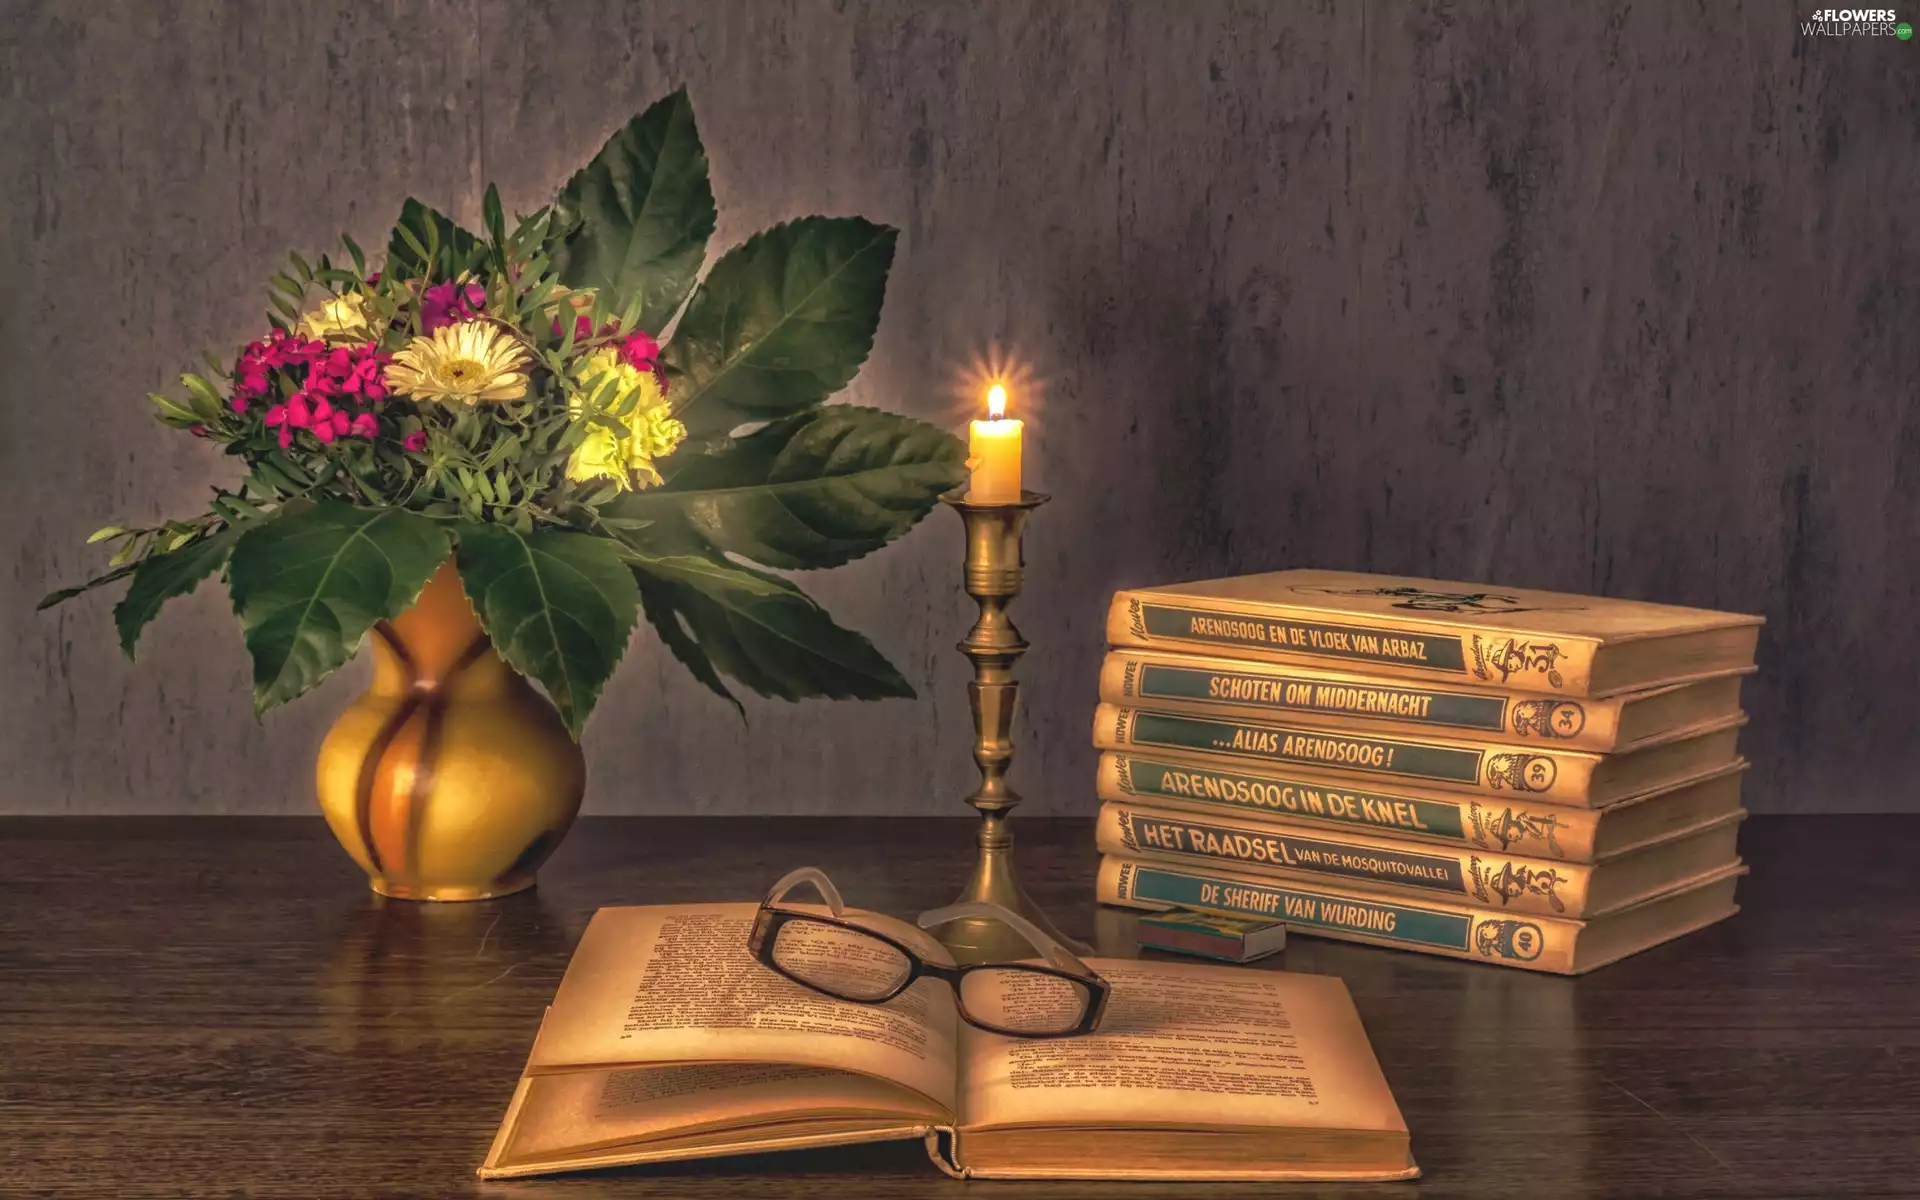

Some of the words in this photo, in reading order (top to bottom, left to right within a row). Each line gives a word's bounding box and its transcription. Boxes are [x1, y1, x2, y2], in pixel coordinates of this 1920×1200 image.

[1191, 616, 1266, 642] ARENDSOOG
[1269, 625, 1288, 645] EN
[1290, 627, 1307, 646] DE
[1309, 630, 1352, 651] VLOEK
[1352, 634, 1379, 654] VAN
[1382, 638, 1428, 660] ARBAZ
[1524, 645, 1554, 673] 31
[1123, 660, 1138, 697] NOWEE
[1208, 676, 1282, 703] SCHOTEN
[1285, 683, 1311, 705] OM
[1315, 687, 1432, 717] MIDDERNACHT
[1115, 708, 1132, 744] NOWEE
[1558, 708, 1575, 730] 34
[1530, 763, 1547, 783] 39
[1161, 771, 1297, 810] ARENDSOOG
[1299, 789, 1324, 814] IN
[1326, 793, 1361, 819] DE
[1361, 797, 1428, 830] KNEL
[1143, 823, 1185, 850] HET
[1187, 828, 1298, 866] RAADSEL
[1296, 848, 1321, 864] VAN
[1323, 851, 1340, 866] DE
[1341, 855, 1449, 881] MOSQUITOVALLEI
[1118, 863, 1132, 900] NOWEE
[1200, 883, 1220, 904] DE
[1223, 887, 1281, 914] SHERIFF
[1284, 896, 1316, 919] VAN
[1320, 903, 1397, 932] WURDING
[1518, 931, 1533, 950] 40
